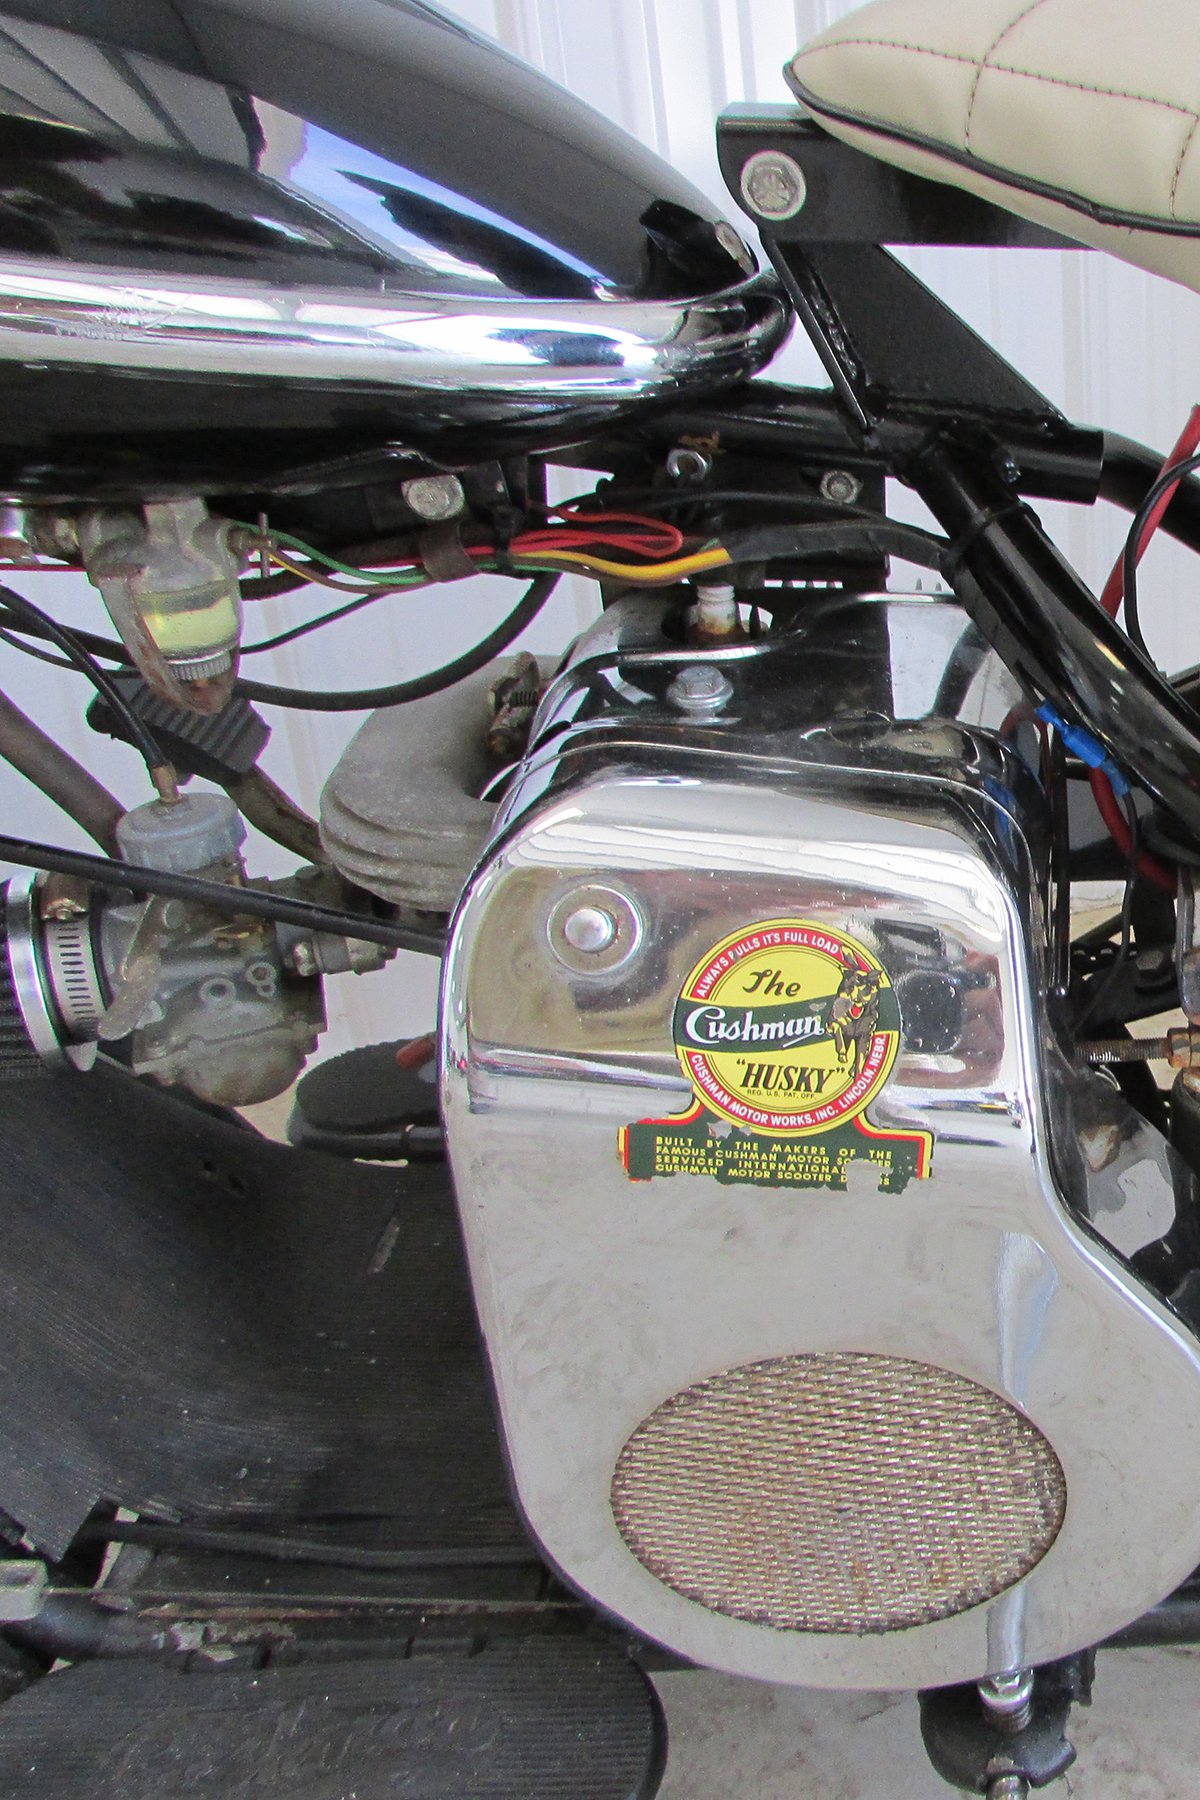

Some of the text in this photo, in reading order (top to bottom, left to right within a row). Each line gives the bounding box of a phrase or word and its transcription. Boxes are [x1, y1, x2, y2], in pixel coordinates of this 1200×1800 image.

[696, 931, 839, 998] ALWAYS PULLS IT'S FULL LOAD
[742, 969, 801, 997] The
[685, 1006, 825, 1048] Cushman
[691, 1054, 732, 1105] CUSHMAN
[729, 1101, 769, 1124] MOTOR
[816, 1106, 838, 1121] INC.
[869, 1035, 887, 1066] NEBR.
[656, 1136, 892, 1160] BUILT BY THE MAKERS OF THE
[656, 1146, 892, 1168] FAMOUS CUSHMAN MOTOR SCER
[656, 1155, 724, 1167] SERVICED
[655, 1164, 718, 1175] CUSHMAN
[728, 1168, 771, 1179] MOTOR
[777, 1171, 832, 1183] SCOOTER
